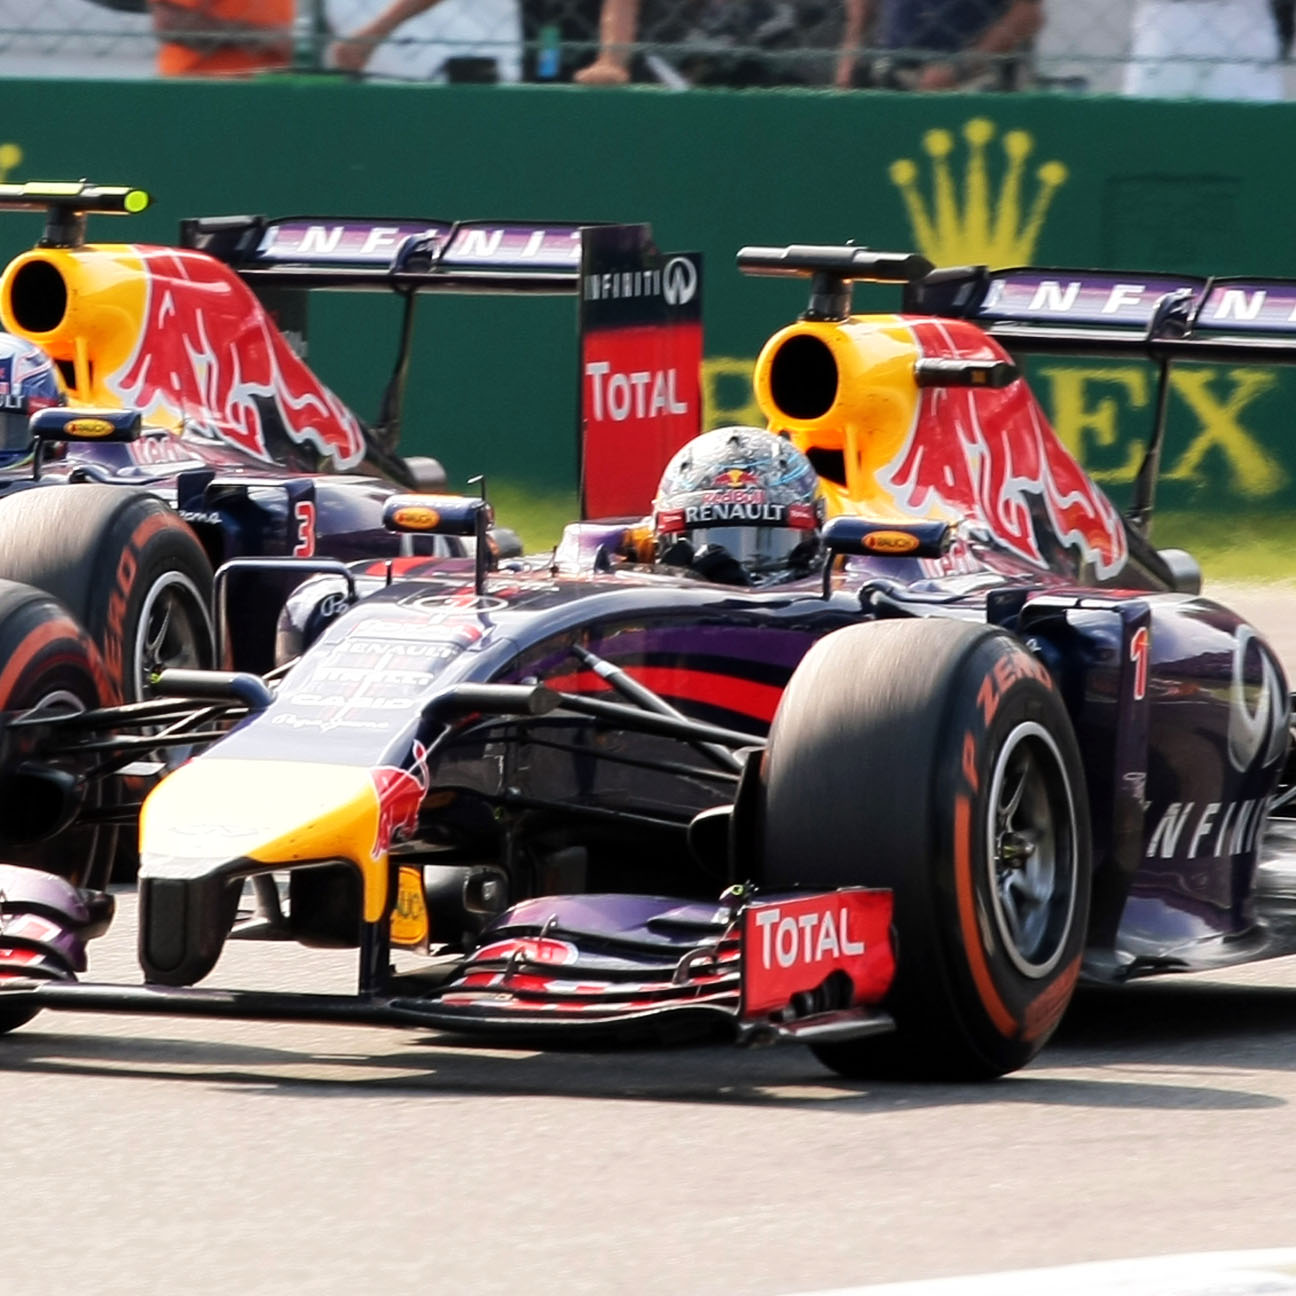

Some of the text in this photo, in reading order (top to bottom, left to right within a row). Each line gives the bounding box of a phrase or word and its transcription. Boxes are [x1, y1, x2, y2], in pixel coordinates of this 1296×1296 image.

[585, 361, 688, 422] TOTAL
[293, 500, 317, 559] 3
[685, 505, 785, 523] RENAULT
[1129, 626, 1149, 700] 1
[756, 907, 865, 970] TOTAL
